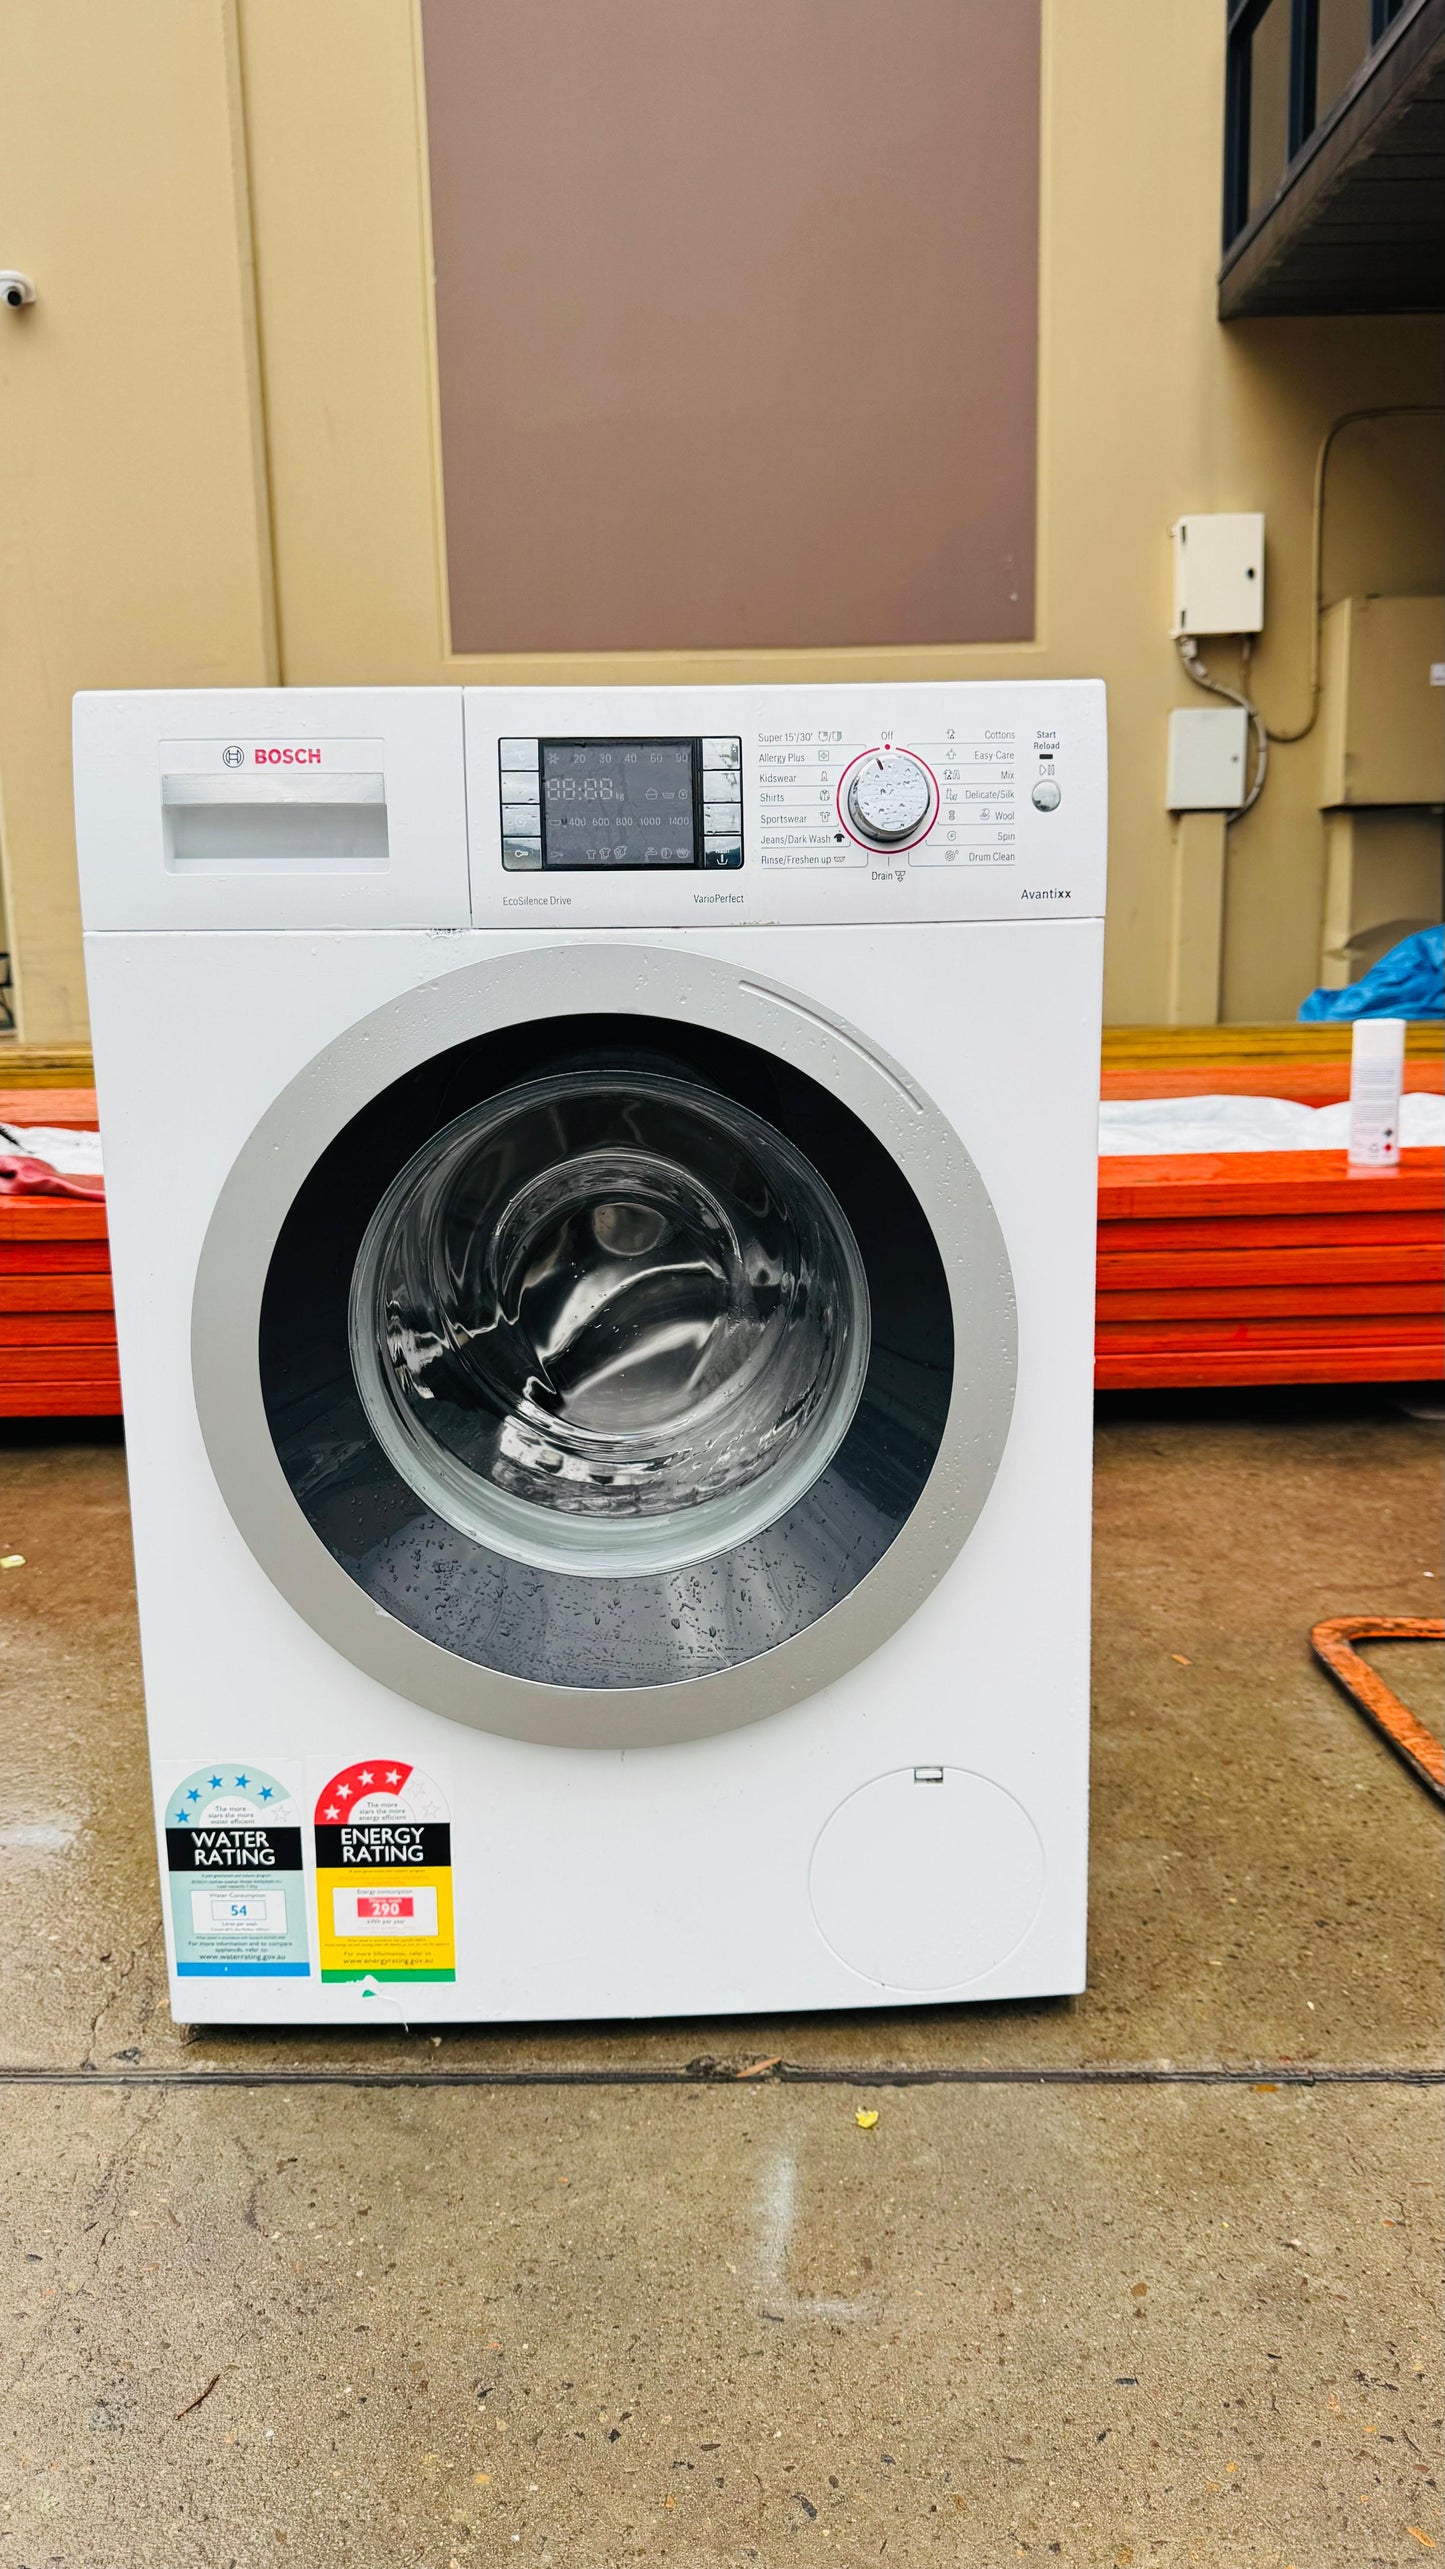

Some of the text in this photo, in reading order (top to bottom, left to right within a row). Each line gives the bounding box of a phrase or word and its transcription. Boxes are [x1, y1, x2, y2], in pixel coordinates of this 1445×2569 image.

[758, 733, 782, 743] Super
[881, 731, 893, 740] Off
[985, 730, 1015, 739] Cottons
[1036, 731, 1056, 739] Start
[1033, 742, 1060, 750] Reload
[254, 748, 321, 764] BOSCH
[573, 753, 688, 764] 20 30 40 60 90
[759, 753, 805, 763] Allergy Plus
[759, 774, 797, 783] Kidswear
[1001, 771, 1015, 779] Mix
[760, 793, 785, 802] Shirts
[965, 790, 1015, 799] Delicate/Silk
[760, 815, 807, 824] Sportswear
[995, 811, 1015, 820] Wool
[569, 816, 689, 826] 400 600 800 1000 1400
[761, 834, 831, 844] Jeans/Dark Wash
[998, 832, 1015, 841] Spin
[761, 855, 819, 866] Rinse/Freshen
[969, 852, 1015, 861] Drum Clean
[872, 871, 893, 880] Drain
[693, 894, 744, 904] VarioPerfect
[1021, 889, 1071, 899] Avantixx
[503, 896, 572, 906] EcoSilence Drive
[191, 1830, 270, 1848] WATER
[340, 1827, 425, 1845] ENERGY
[194, 1848, 276, 1866] RATING
[343, 1845, 424, 1863] RATING
[231, 1905, 247, 1916] 54
[372, 1902, 400, 1916] 290
